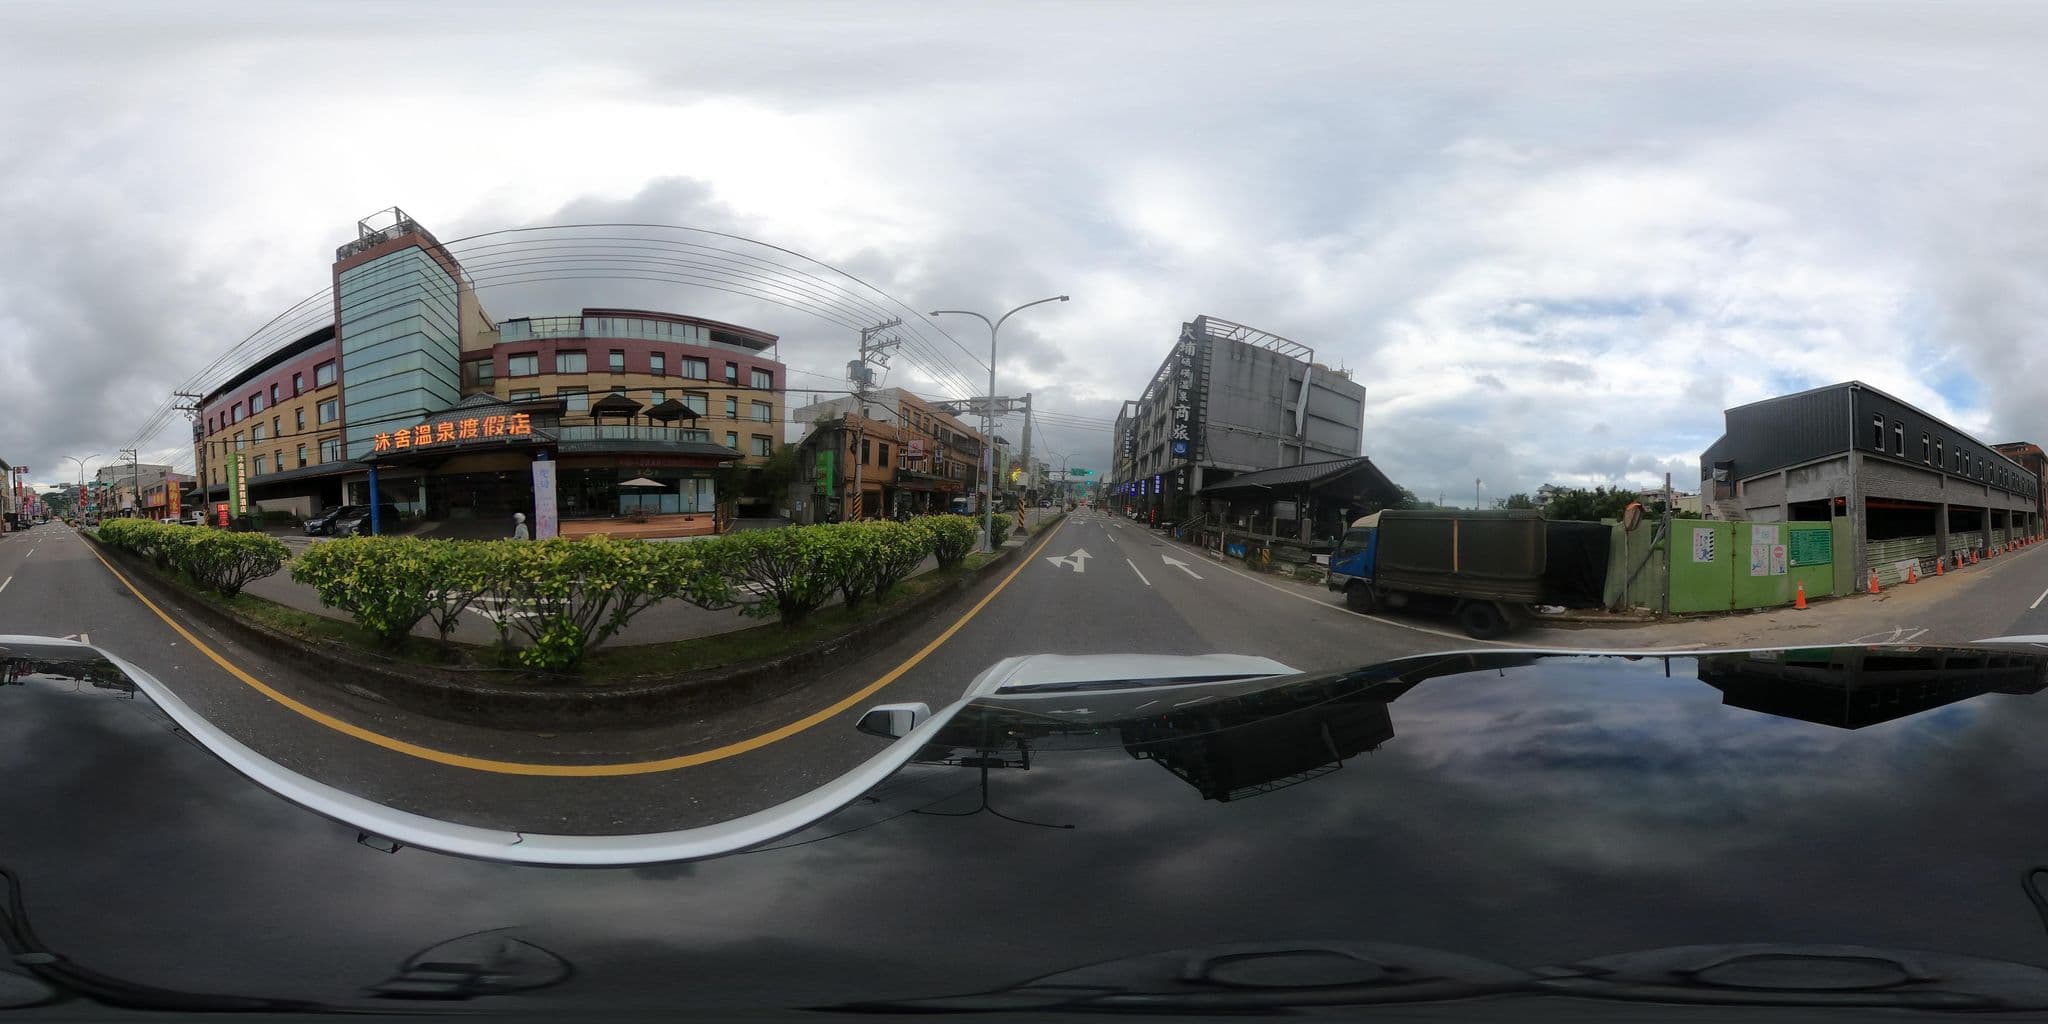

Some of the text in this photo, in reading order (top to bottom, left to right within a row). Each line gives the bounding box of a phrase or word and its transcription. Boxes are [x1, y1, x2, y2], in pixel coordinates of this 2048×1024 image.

[374, 413, 532, 451] 沐舍溫泉渡假店
